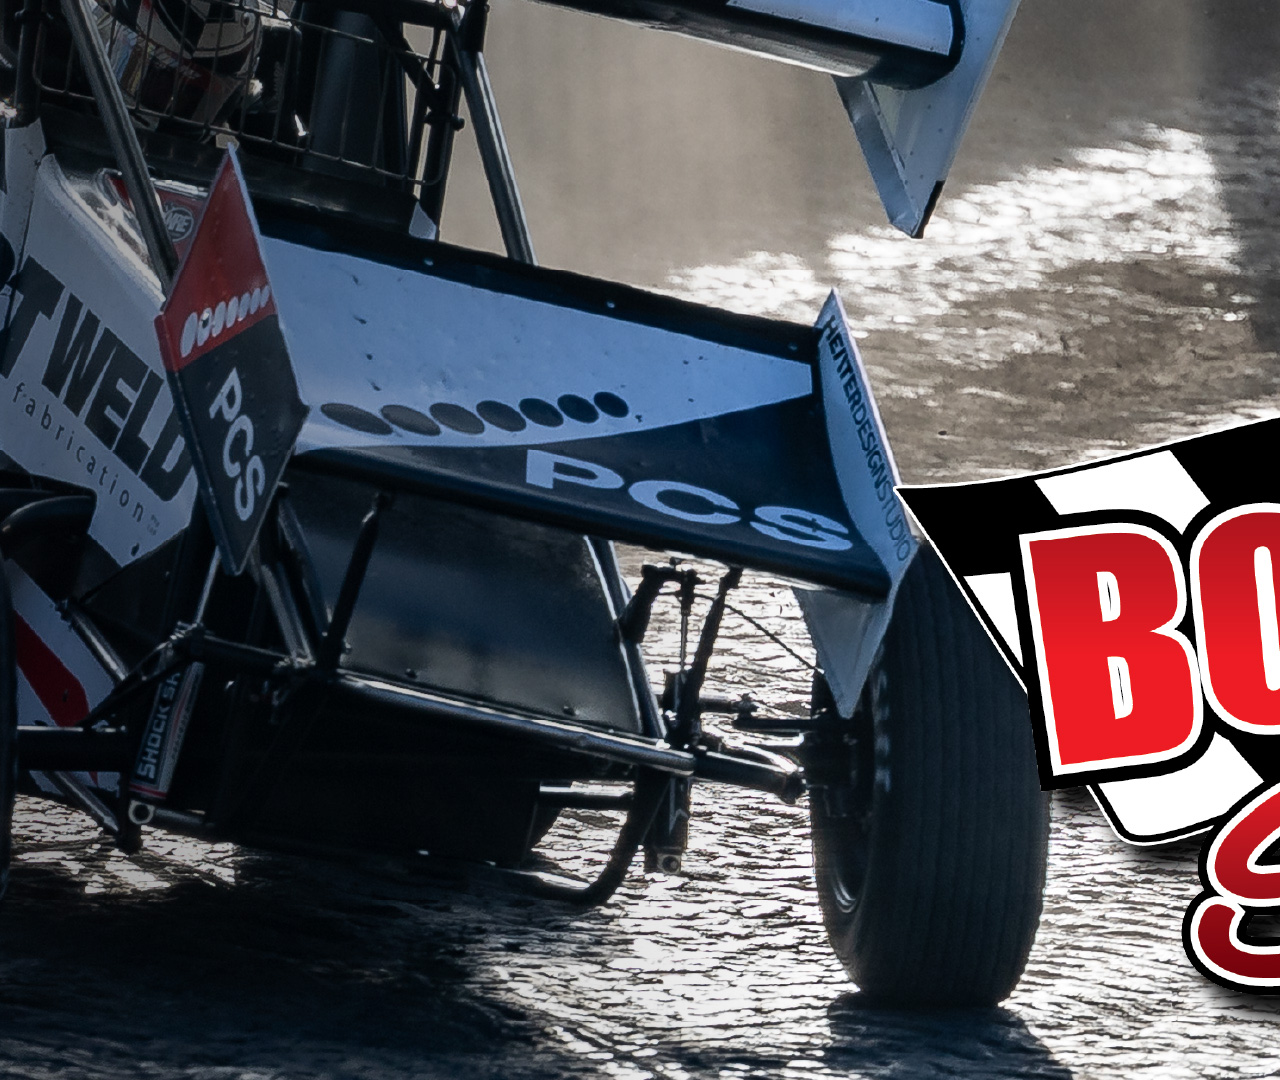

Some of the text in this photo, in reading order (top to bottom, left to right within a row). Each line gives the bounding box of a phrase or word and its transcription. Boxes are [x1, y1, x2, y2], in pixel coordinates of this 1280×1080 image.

[12, 381, 146, 523] fabrication
[41, 292, 192, 502] WELD
[209, 366, 266, 521] PCS
[524, 448, 854, 552] PCS
